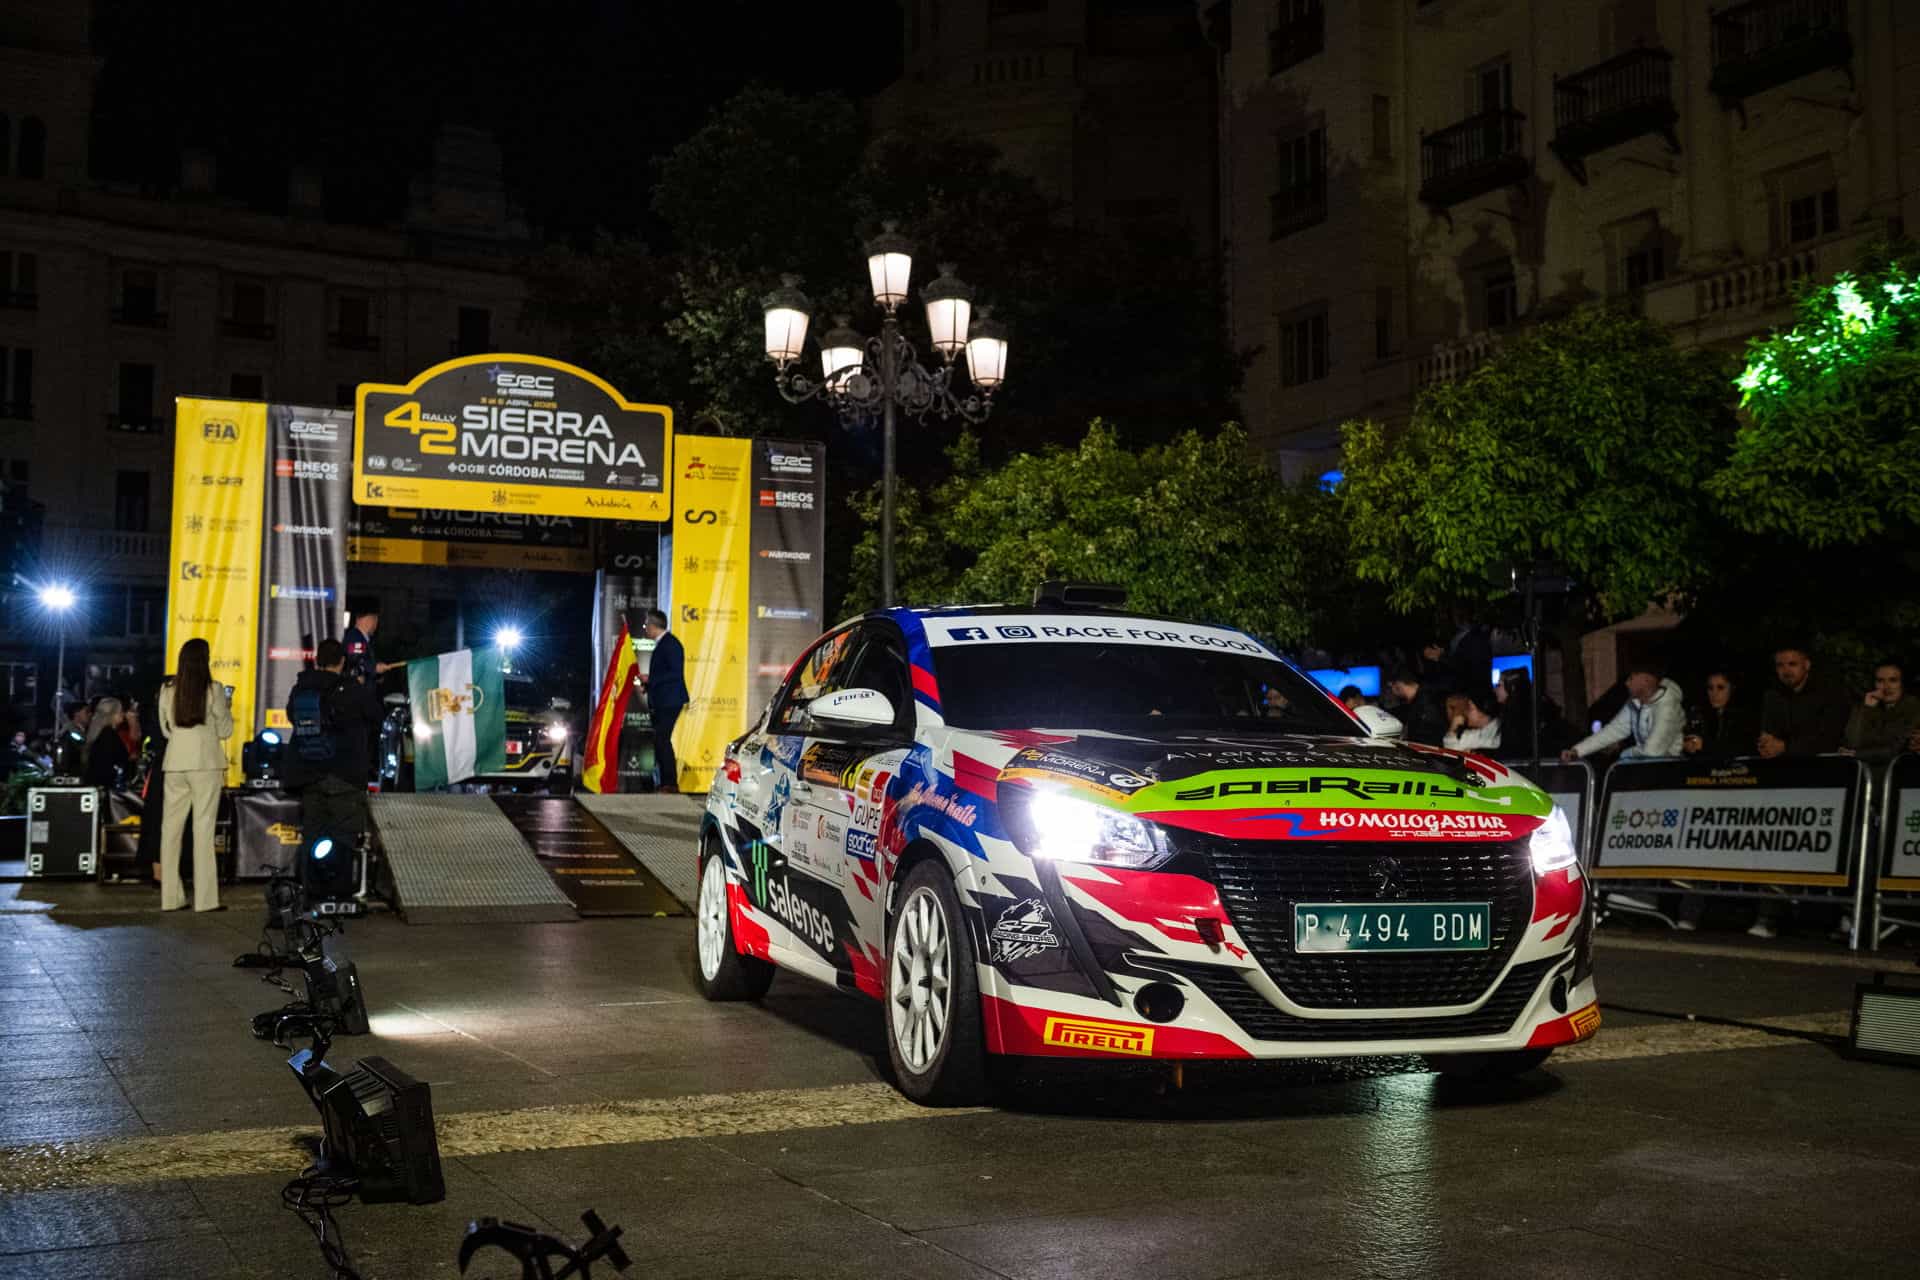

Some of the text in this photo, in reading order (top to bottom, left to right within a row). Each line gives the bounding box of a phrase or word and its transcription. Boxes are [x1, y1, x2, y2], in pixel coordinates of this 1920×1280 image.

[497, 374, 554, 389] ERC
[421, 412, 456, 423] RALLY
[463, 405, 613, 439] SIERRA
[384, 401, 456, 455] 42
[461, 432, 646, 467] MORENA
[295, 461, 338, 473] ENEOS
[488, 462, 548, 478] CÓRDOBA
[771, 455, 812, 467] ERC
[776, 491, 814, 502] ENEOS
[1041, 626, 1262, 654] RACE FOR GOOD
[1690, 807, 1834, 826] PATRIMONIO DE
[1819, 817, 1833, 826] LA
[1608, 832, 1673, 849] CÓRDOBA
[1685, 829, 1832, 853] HUMANIDAD
[768, 875, 835, 953] salense
[1305, 913, 1482, 942] P 4494 BDM
[1052, 1021, 1147, 1051] PIRELLI
